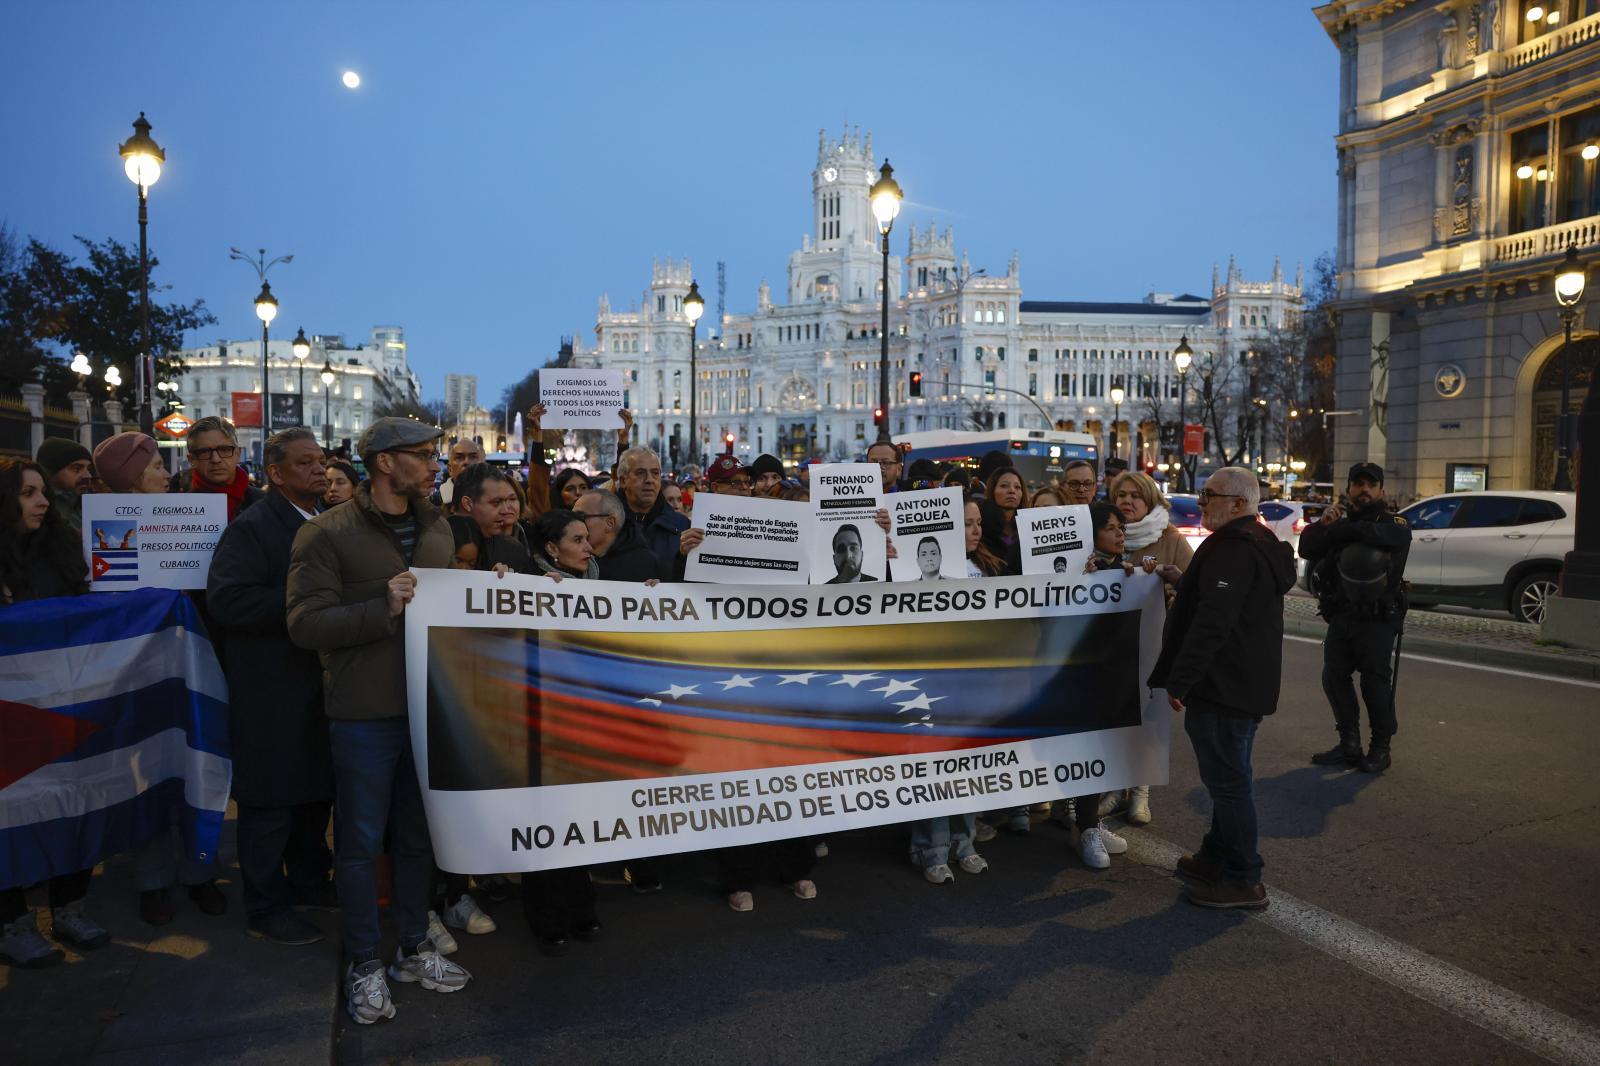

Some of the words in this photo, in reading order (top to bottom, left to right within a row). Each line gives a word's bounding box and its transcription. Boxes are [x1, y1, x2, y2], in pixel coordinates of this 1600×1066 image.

[556, 379, 592, 387] EXIGIMOS
[594, 379, 607, 387] LOS
[583, 389, 620, 397] HUMANOS
[541, 399, 551, 407] DE
[553, 399, 579, 407] TODOS
[563, 408, 601, 417] POLÍTICOS
[820, 475, 874, 485] FERNANDO
[833, 485, 864, 496] NOYA
[895, 497, 951, 511] ANTONIO
[115, 506, 143, 515] CTDC:
[152, 506, 193, 514] EXIGIMOS
[194, 506, 205, 514] LA
[709, 513, 726, 522] Sabe
[734, 516, 764, 525] gobierno
[765, 518, 773, 526] de
[774, 519, 798, 528] España
[896, 509, 950, 524] SEQUEA
[138, 524, 179, 532] AMNISTIA
[180, 524, 201, 532] PARA
[203, 524, 220, 532] LOS
[1031, 516, 1076, 531] MERYS
[734, 525, 758, 533] quedan
[767, 527, 799, 536] españoles
[705, 530, 727, 538] presos
[727, 530, 754, 539] políticos
[763, 534, 799, 543] Venezuela?
[1033, 531, 1077, 545] TORRES
[141, 542, 172, 551] PRESOS
[174, 542, 217, 550] POLITICOS
[159, 560, 200, 568] CUBANOS
[701, 555, 724, 563] España
[465, 587, 613, 620] LIBERTAD
[621, 597, 700, 621] PARA
[706, 596, 808, 620] TODOS
[816, 594, 872, 617] LOS
[880, 588, 987, 613] PRESOS
[994, 582, 1122, 609] POLÍTICOS
[631, 782, 716, 808] CIERRE
[720, 779, 750, 799] DE
[755, 774, 798, 796] LOS
[803, 764, 896, 791] CENTROS
[901, 761, 928, 780] DE
[932, 749, 1020, 776] TORTURA
[511, 824, 555, 852] NO
[563, 822, 586, 846] A
[593, 817, 632, 843] LA
[638, 800, 793, 838] IMPUNIDAD
[799, 795, 835, 819] DE
[840, 789, 890, 813] LOS
[896, 772, 1013, 806] CRIMENES
[1018, 767, 1049, 789] DE
[1053, 758, 1107, 783] ODIO
